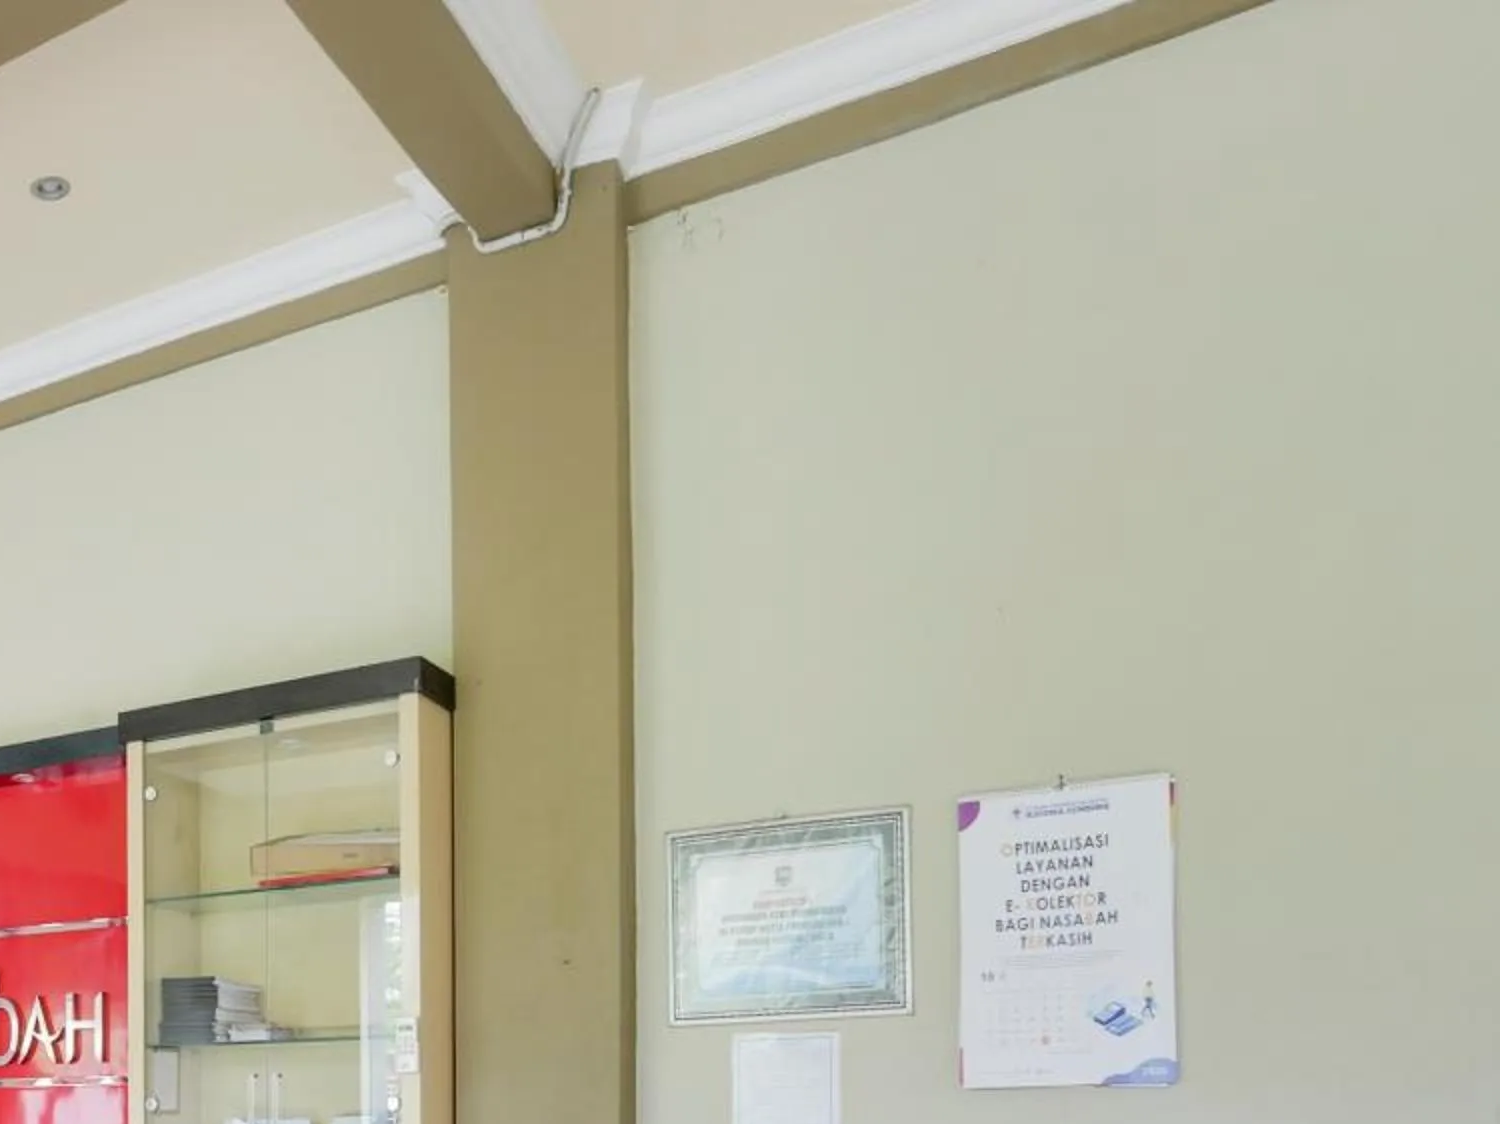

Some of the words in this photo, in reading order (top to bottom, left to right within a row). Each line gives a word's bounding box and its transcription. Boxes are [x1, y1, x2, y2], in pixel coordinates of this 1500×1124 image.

[1000, 833, 1109, 857] OPTIMALISASI
[1015, 855, 1093, 875] LAYANAN
[1020, 875, 1090, 893] DENGAN
[995, 917, 1034, 932] BAGI
